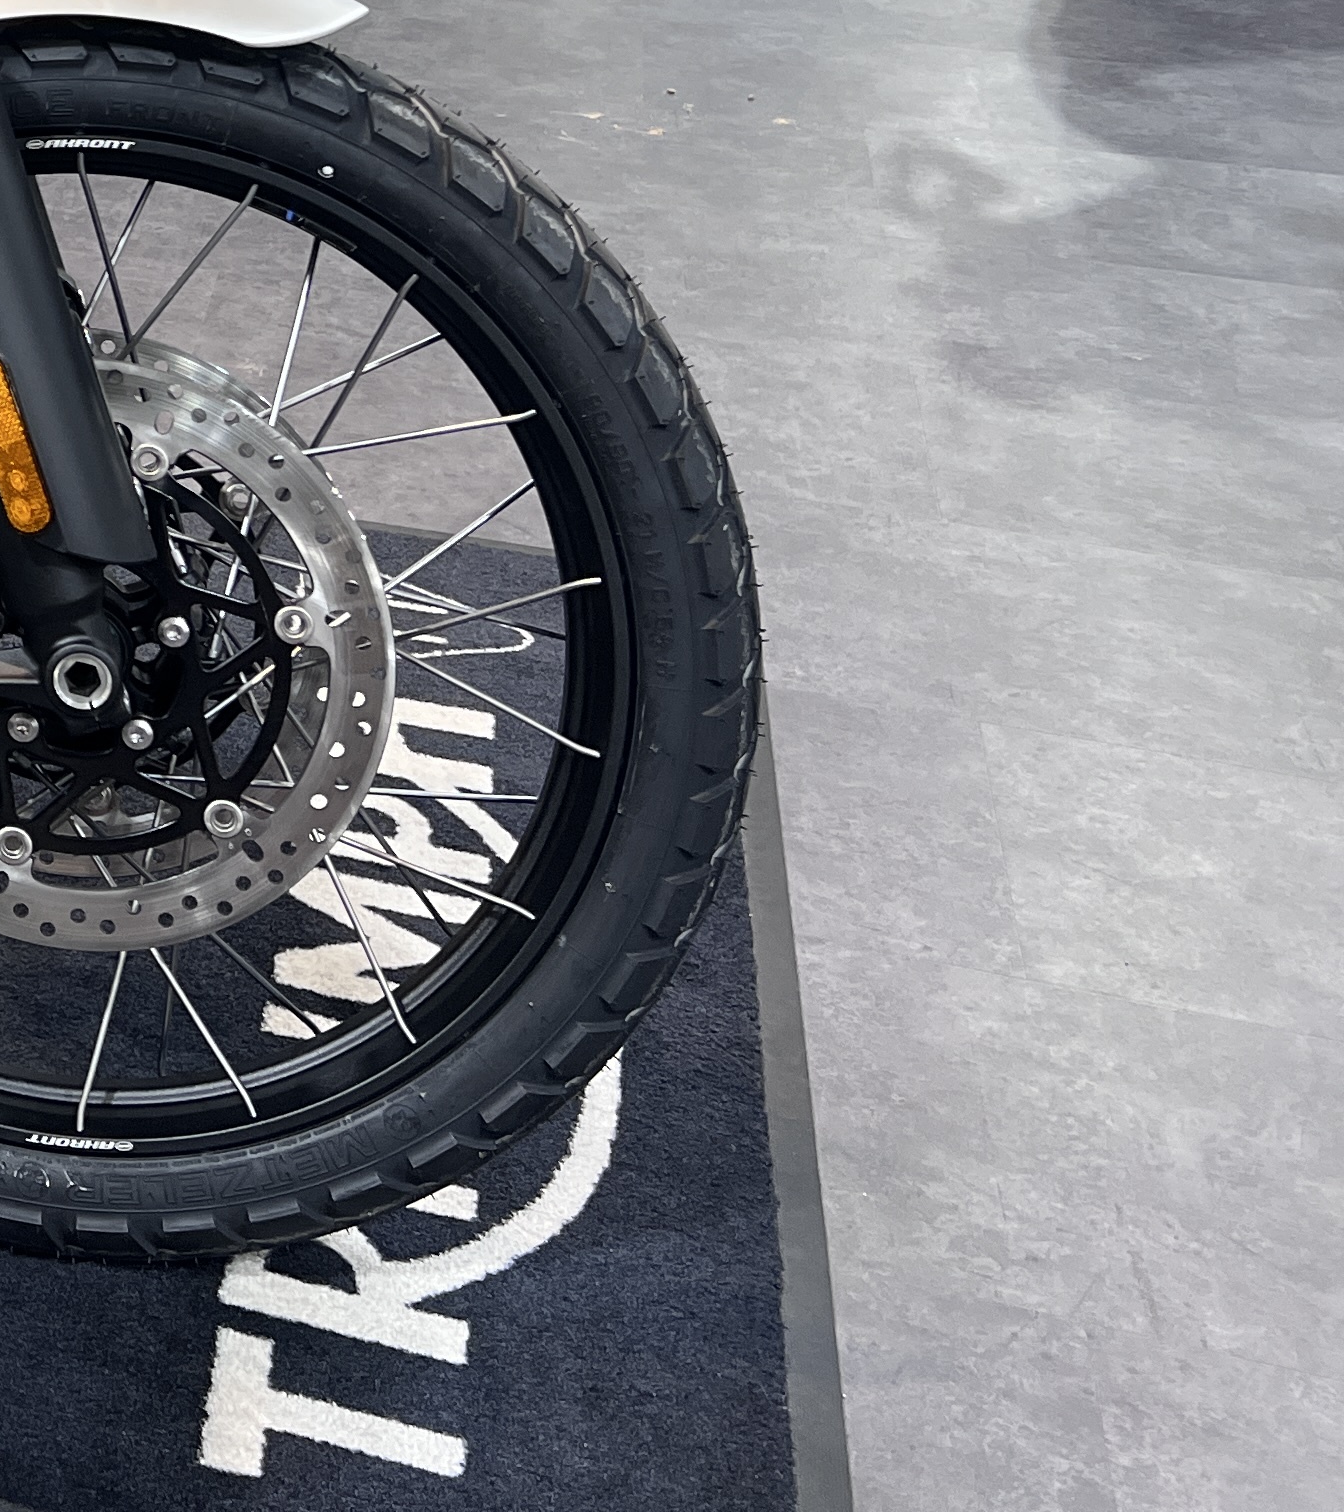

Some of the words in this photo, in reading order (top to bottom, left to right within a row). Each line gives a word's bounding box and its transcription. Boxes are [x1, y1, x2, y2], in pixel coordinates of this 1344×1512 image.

[43, 139, 136, 150] AKRONT
[25, 1133, 115, 1151] AKRONT
[66, 1122, 382, 1206] METZELER
